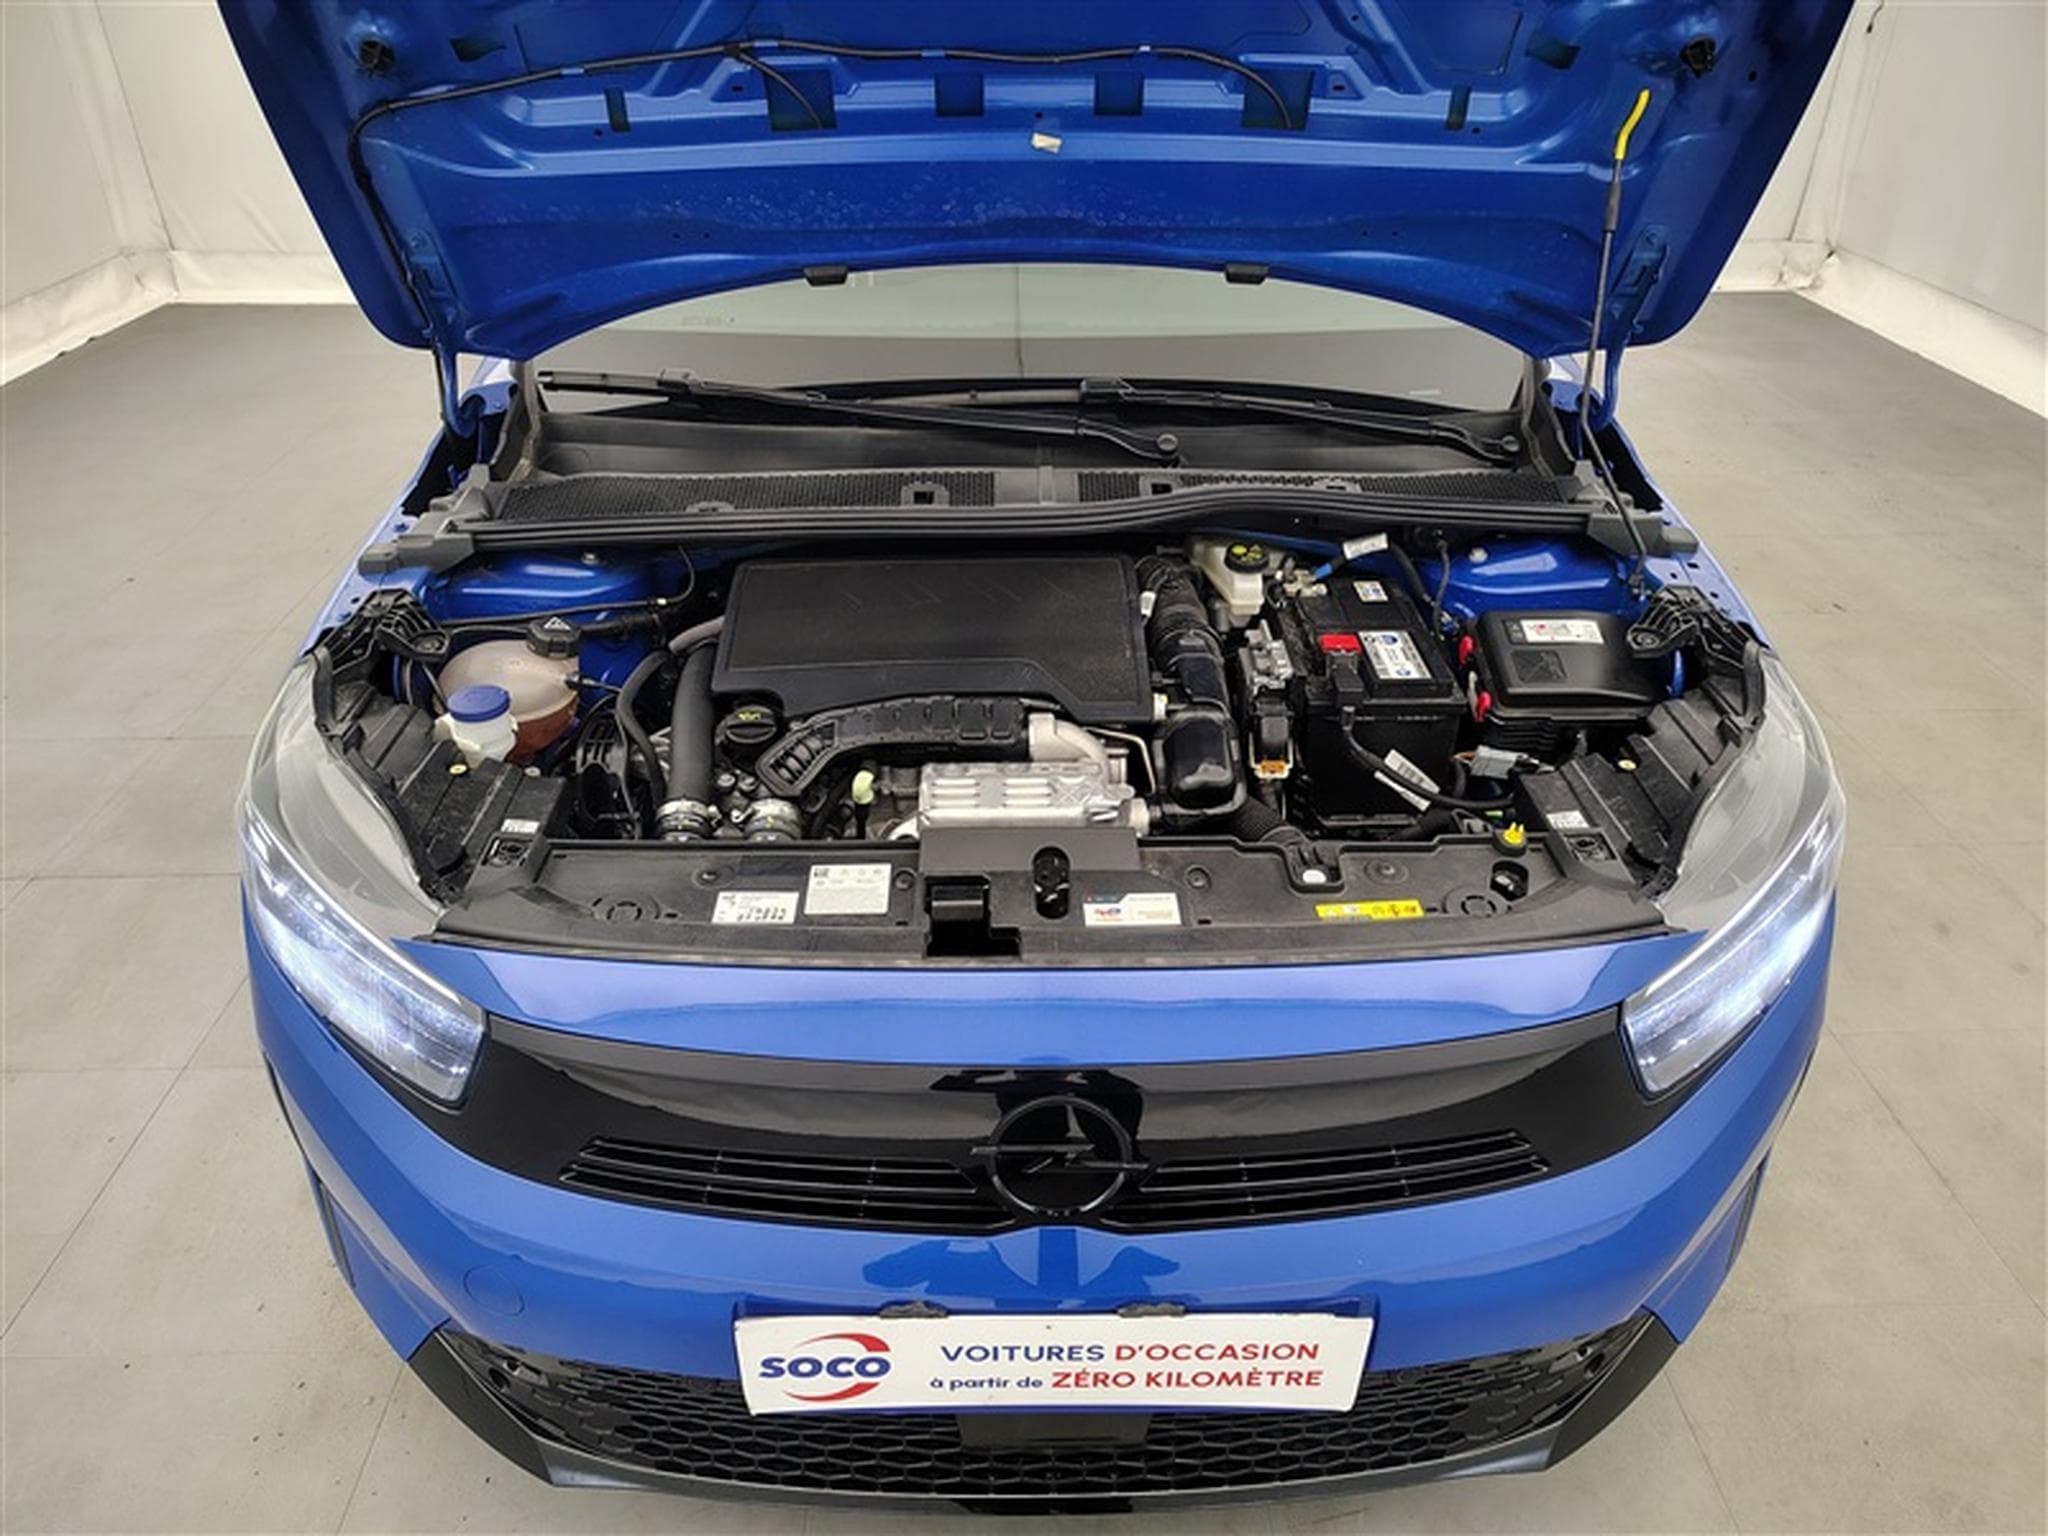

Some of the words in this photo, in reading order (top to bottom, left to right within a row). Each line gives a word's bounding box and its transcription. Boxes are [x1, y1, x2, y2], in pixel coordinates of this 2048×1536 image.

[941, 1345, 1105, 1361] VOITURES
[1116, 1344, 1319, 1360] D'OCCASION
[759, 1357, 890, 1378] SOCO
[929, 1377, 943, 1388] à
[950, 1377, 1010, 1391] partir
[1016, 1377, 1043, 1388] de
[1052, 1368, 1136, 1388] ZÉRO
[1145, 1367, 1323, 1388] KILOMÈTRE
